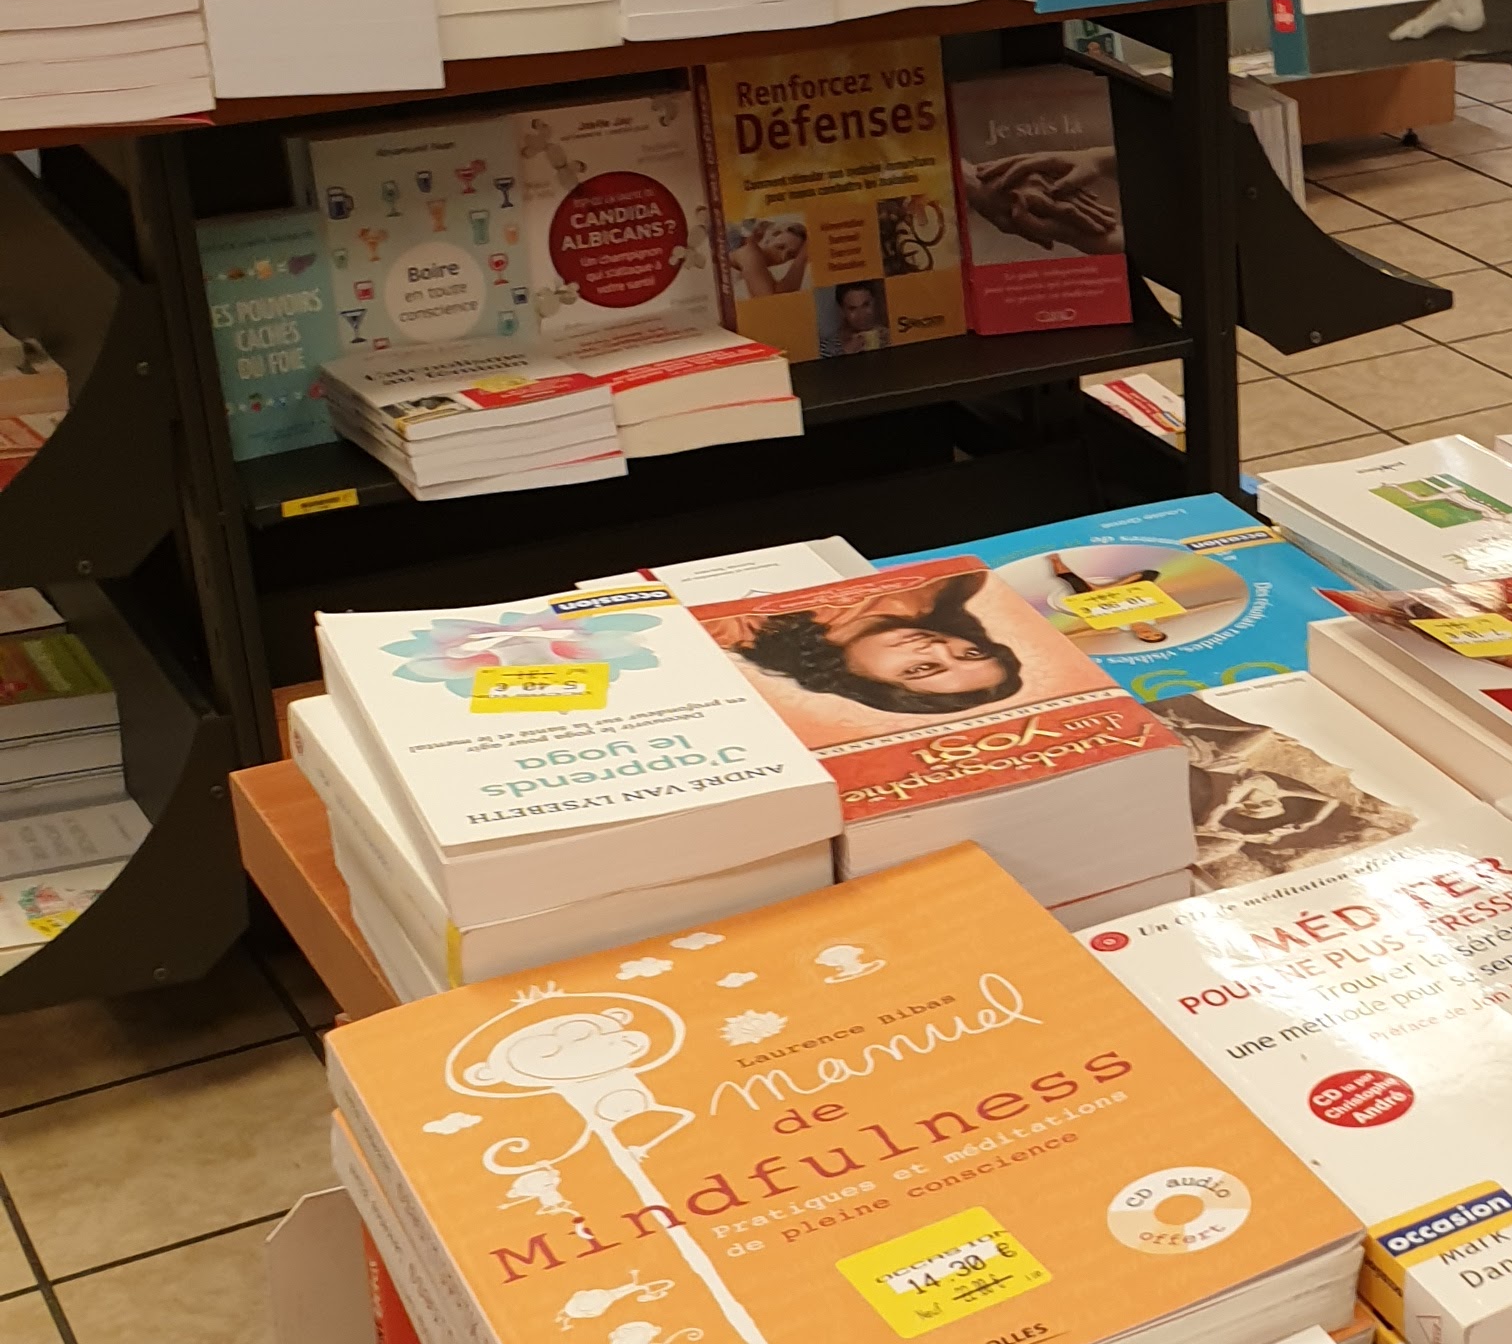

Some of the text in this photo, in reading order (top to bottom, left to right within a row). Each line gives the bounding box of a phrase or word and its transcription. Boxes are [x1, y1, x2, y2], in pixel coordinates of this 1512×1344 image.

[737, 66, 925, 109] Renforcez vos
[735, 99, 937, 155] Défenses
[569, 203, 663, 230] CANDIDA
[408, 261, 459, 283] Boire
[428, 282, 467, 301] toute
[399, 300, 478, 323] conscience
[559, 589, 670, 611] occasion
[481, 744, 747, 799] J'apprends
[841, 722, 1156, 805] Autobiographie
[466, 764, 785, 825] ANDRÉ VAN LYSEBETH
[711, 972, 1043, 1116] manuel
[772, 1101, 850, 1135] de
[490, 1050, 1132, 1285] Mindfulness
[711, 1088, 1128, 1239] Pratiques et méditations
[726, 1130, 1079, 1257] de pleine conscience
[1387, 1195, 1512, 1251] occasion
